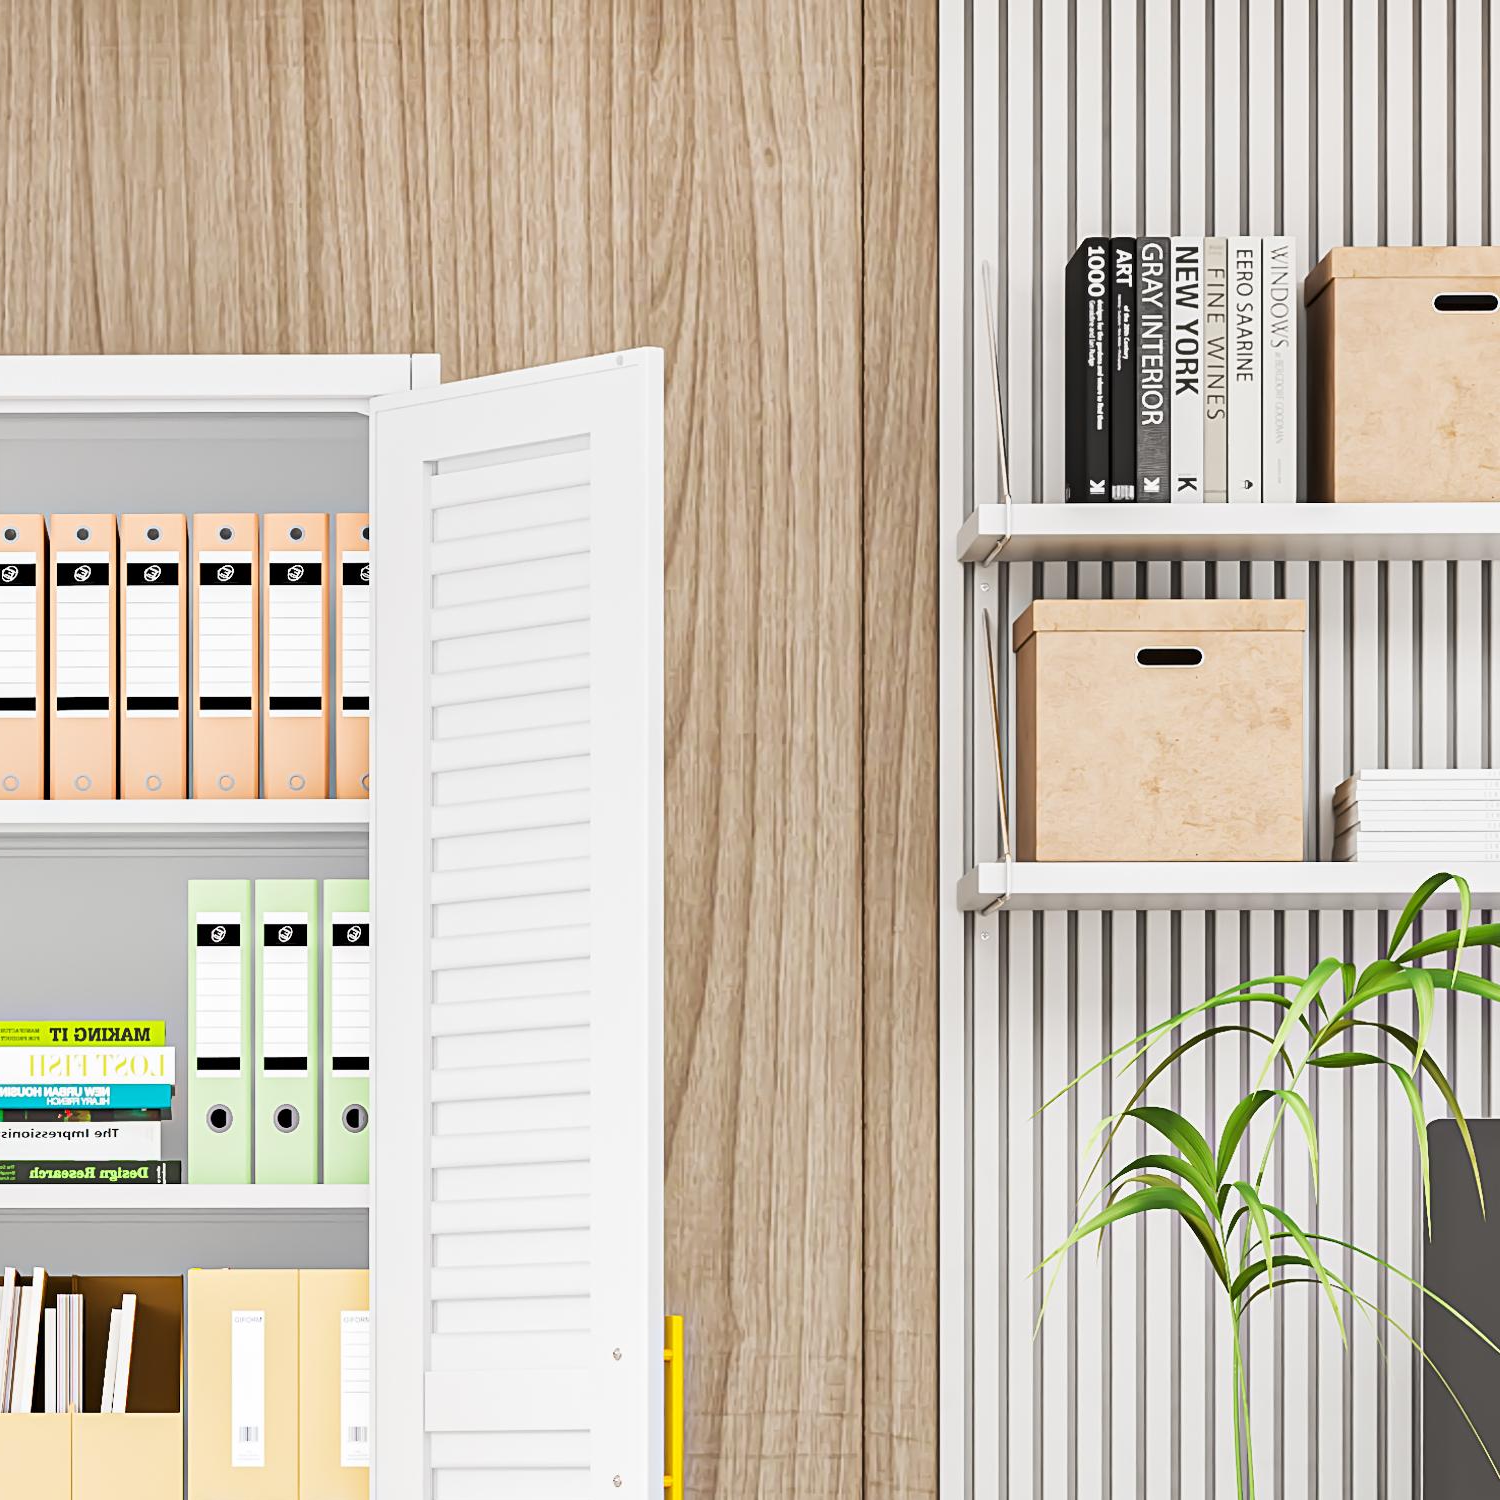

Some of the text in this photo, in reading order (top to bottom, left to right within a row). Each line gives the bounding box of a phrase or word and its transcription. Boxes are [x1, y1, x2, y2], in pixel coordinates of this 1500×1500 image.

[1088, 246, 1106, 298] 1000
[1115, 248, 1132, 286] ART
[1141, 242, 1163, 426] GRAY INTERIOR
[1175, 246, 1199, 396] NEW YORK
[1236, 248, 1254, 382] EERO SAARINE
[1270, 246, 1290, 349] WINDOWS
[1206, 268, 1226, 421] FINE WINES
